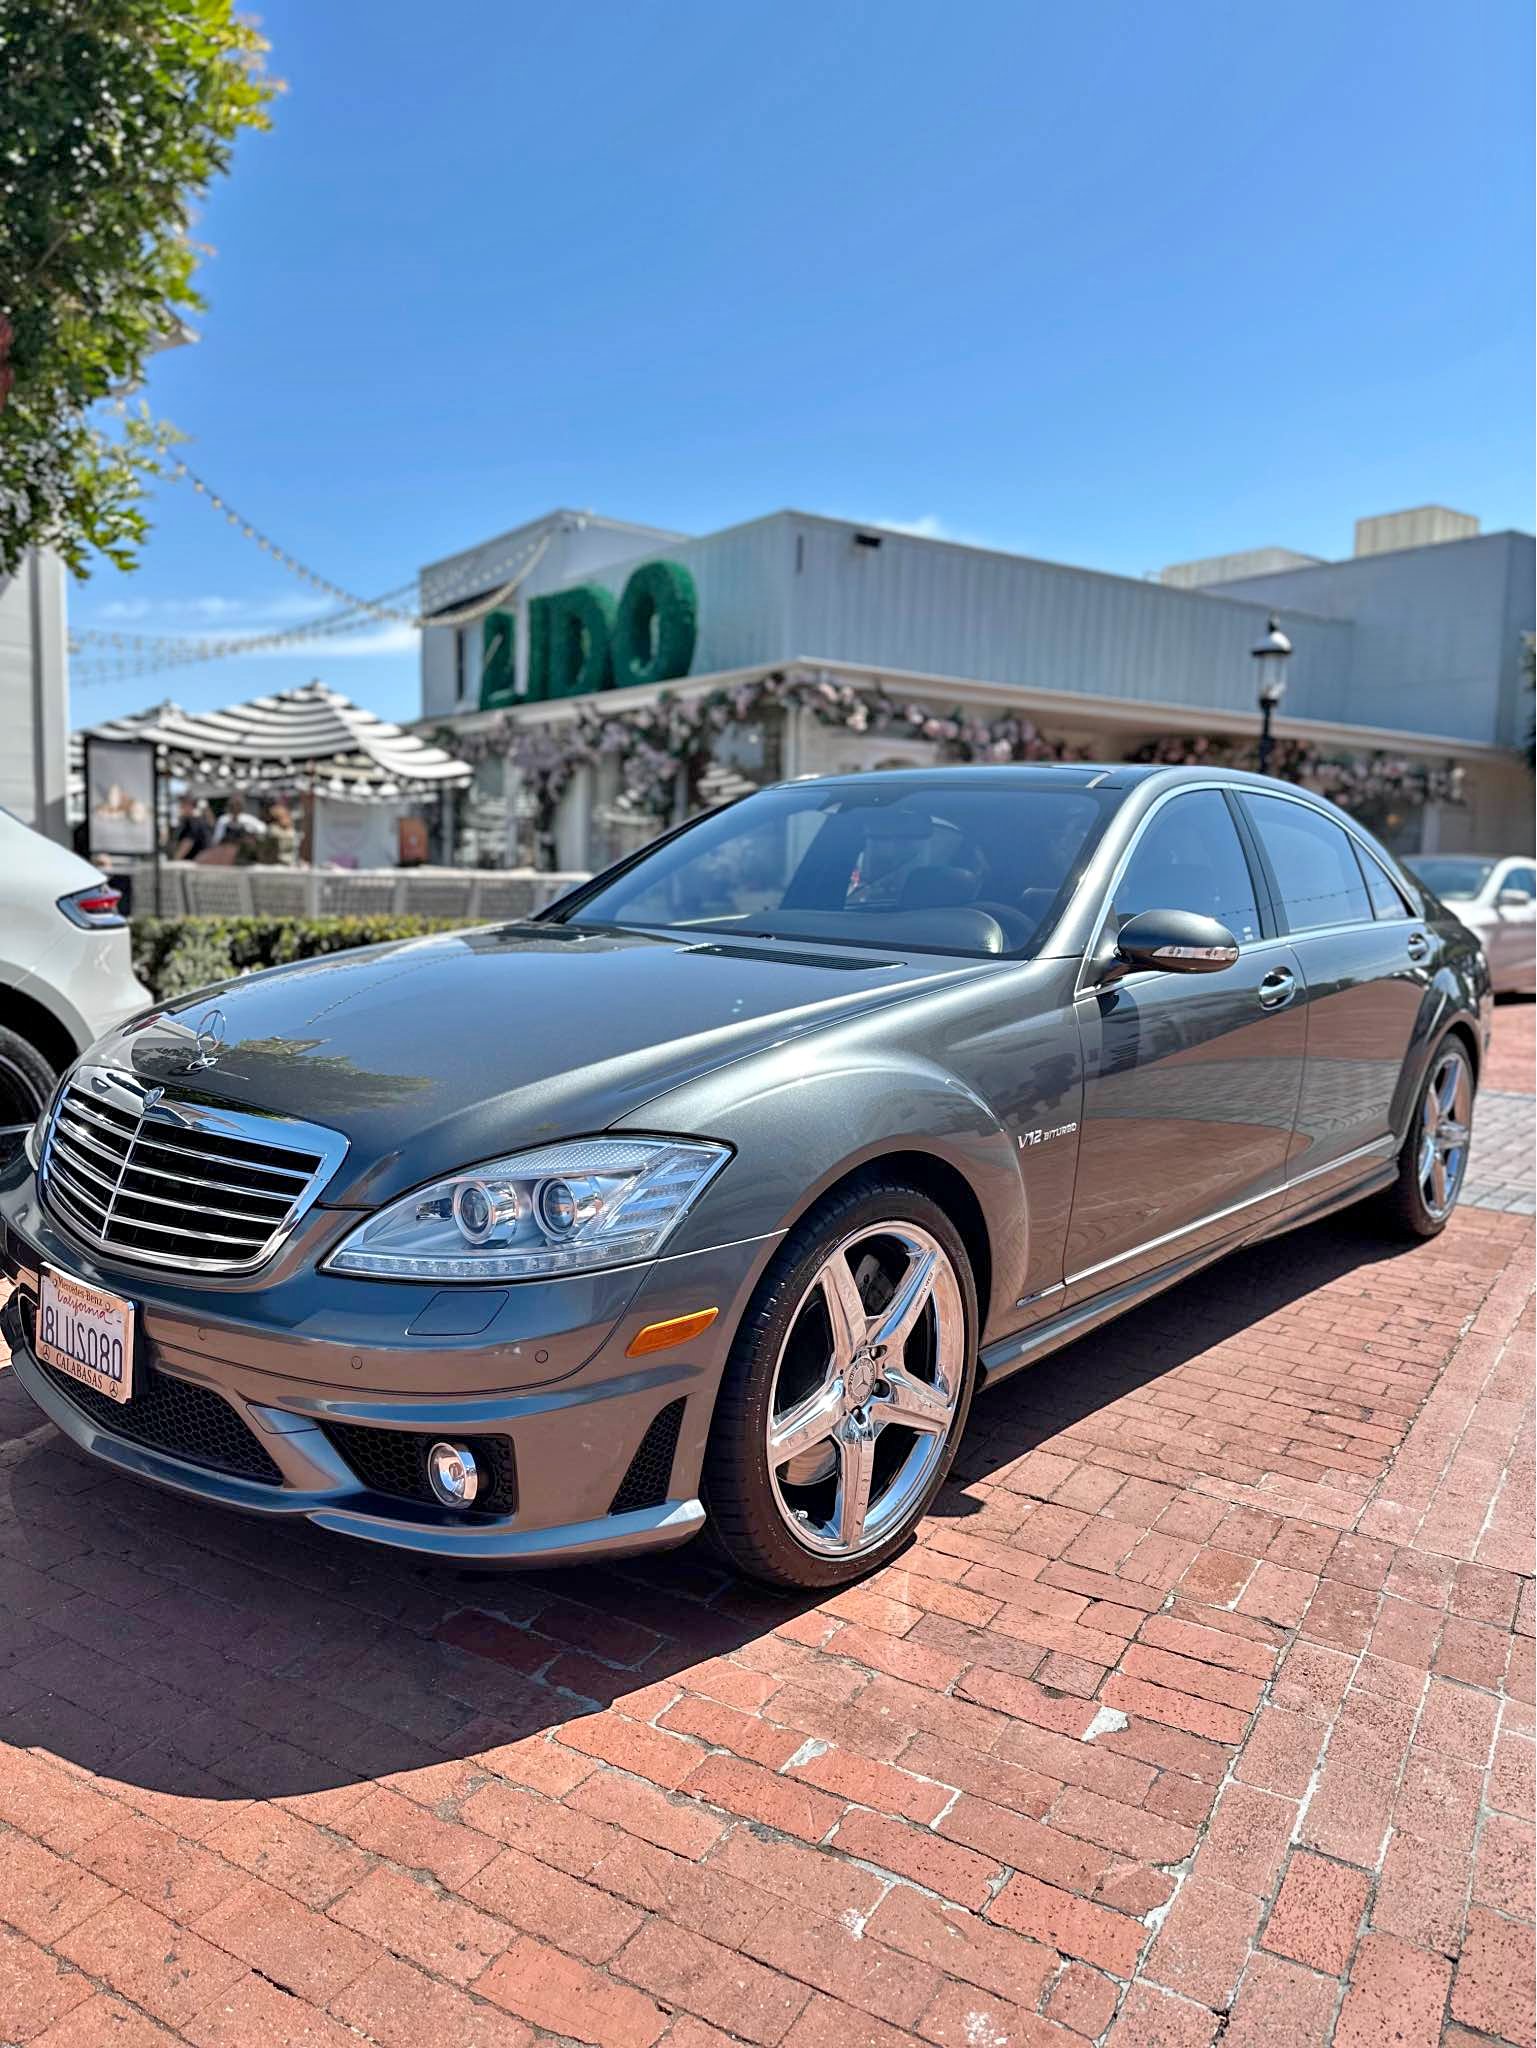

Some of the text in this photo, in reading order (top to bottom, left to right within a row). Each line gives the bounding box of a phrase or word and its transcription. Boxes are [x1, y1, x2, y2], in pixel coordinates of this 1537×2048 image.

[1018, 1122, 1077, 1149] V12 BITURBO
[57, 1290, 108, 1320] California
[58, 1277, 103, 1307] Mercedes-Benz
[45, 1305, 123, 1383] 8LUS080
[56, 1352, 103, 1390] CALABASAS
